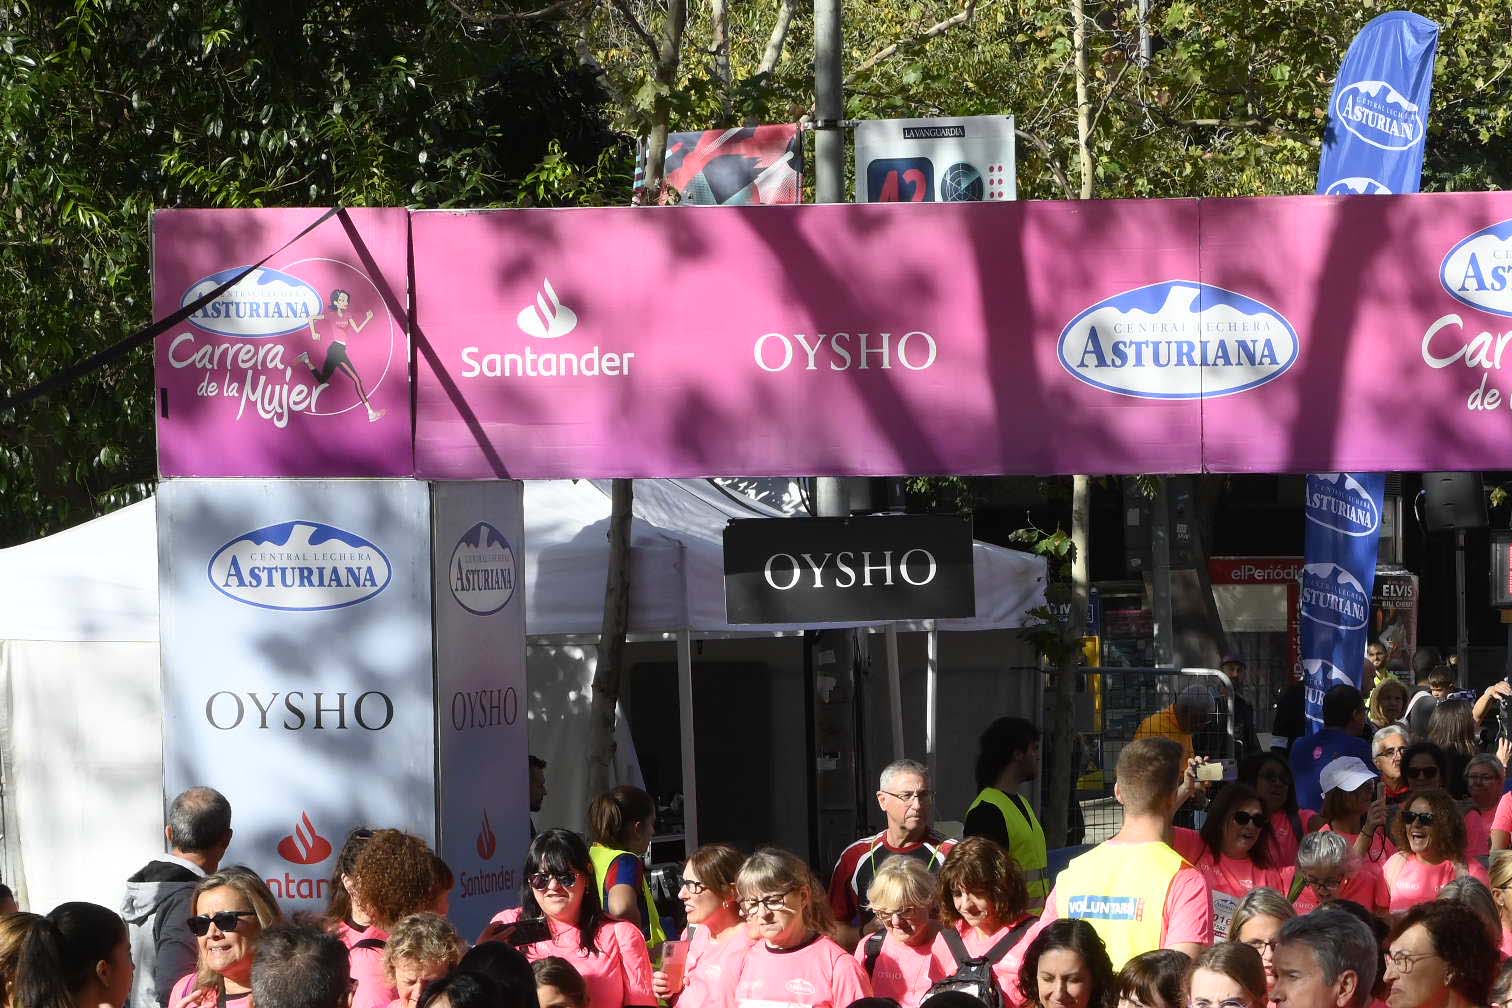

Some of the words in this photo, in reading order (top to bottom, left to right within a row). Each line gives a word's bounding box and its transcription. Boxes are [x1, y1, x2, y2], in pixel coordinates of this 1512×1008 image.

[915, 127, 963, 137] VANGUARDIA
[1113, 323, 1186, 334] CENTRAL
[1197, 321, 1271, 333] LECHERA
[168, 332, 285, 370] Carrera
[461, 345, 635, 378] Santander
[753, 331, 937, 371] OYSHO
[1077, 326, 1281, 369] ASTURIANA
[197, 371, 219, 397] de
[223, 370, 239, 398] la
[236, 367, 329, 428] Mujer
[1468, 372, 1503, 411] de
[222, 555, 378, 588] ASTURIANA
[250, 553, 305, 561] CENTRAL
[313, 552, 371, 561] LECHERA
[455, 556, 512, 592] ASTURIANA
[764, 548, 937, 590] OYSHO
[1302, 587, 1365, 621] STURIANA
[1382, 584, 1413, 597] ELVIS
[205, 691, 394, 731] OYSHO
[452, 687, 518, 731] OYSHO
[460, 868, 517, 897] Santander
